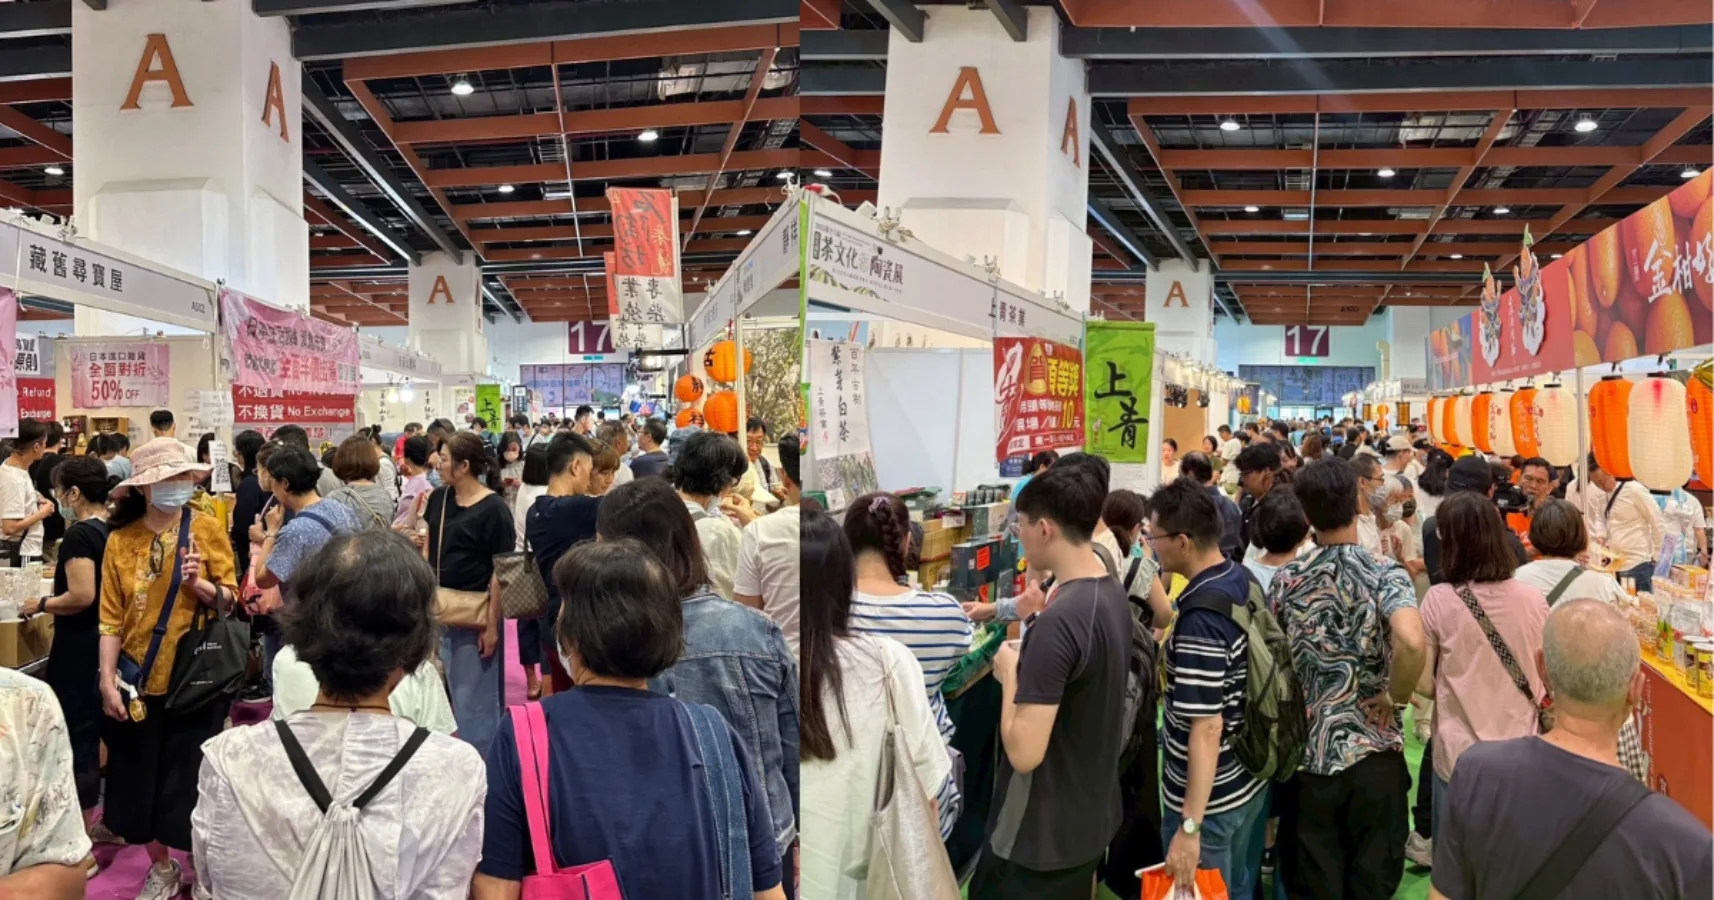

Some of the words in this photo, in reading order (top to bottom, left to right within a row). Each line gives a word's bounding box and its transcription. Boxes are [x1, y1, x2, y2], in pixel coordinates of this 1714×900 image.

[120, 34, 194, 110] A
[261, 60, 289, 143] A
[929, 66, 1002, 134] A
[1060, 96, 1080, 168] A
[29, 244, 123, 292] 藏舊尋寶屋
[821, 235, 858, 270] 茶文化
[426, 275, 455, 304] A
[1162, 280, 1190, 308] A
[571, 320, 611, 352] 17
[1287, 325, 1327, 355] 17
[89, 363, 146, 377] 全面對折
[22, 387, 52, 398] Refund
[91, 380, 123, 400] 50%
[125, 390, 140, 399] OFF
[1094, 361, 1149, 450] 上青
[20, 408, 52, 419] Exchange
[238, 404, 284, 420] 不換貨
[287, 407, 301, 416] No
[304, 406, 350, 418] Exchange
